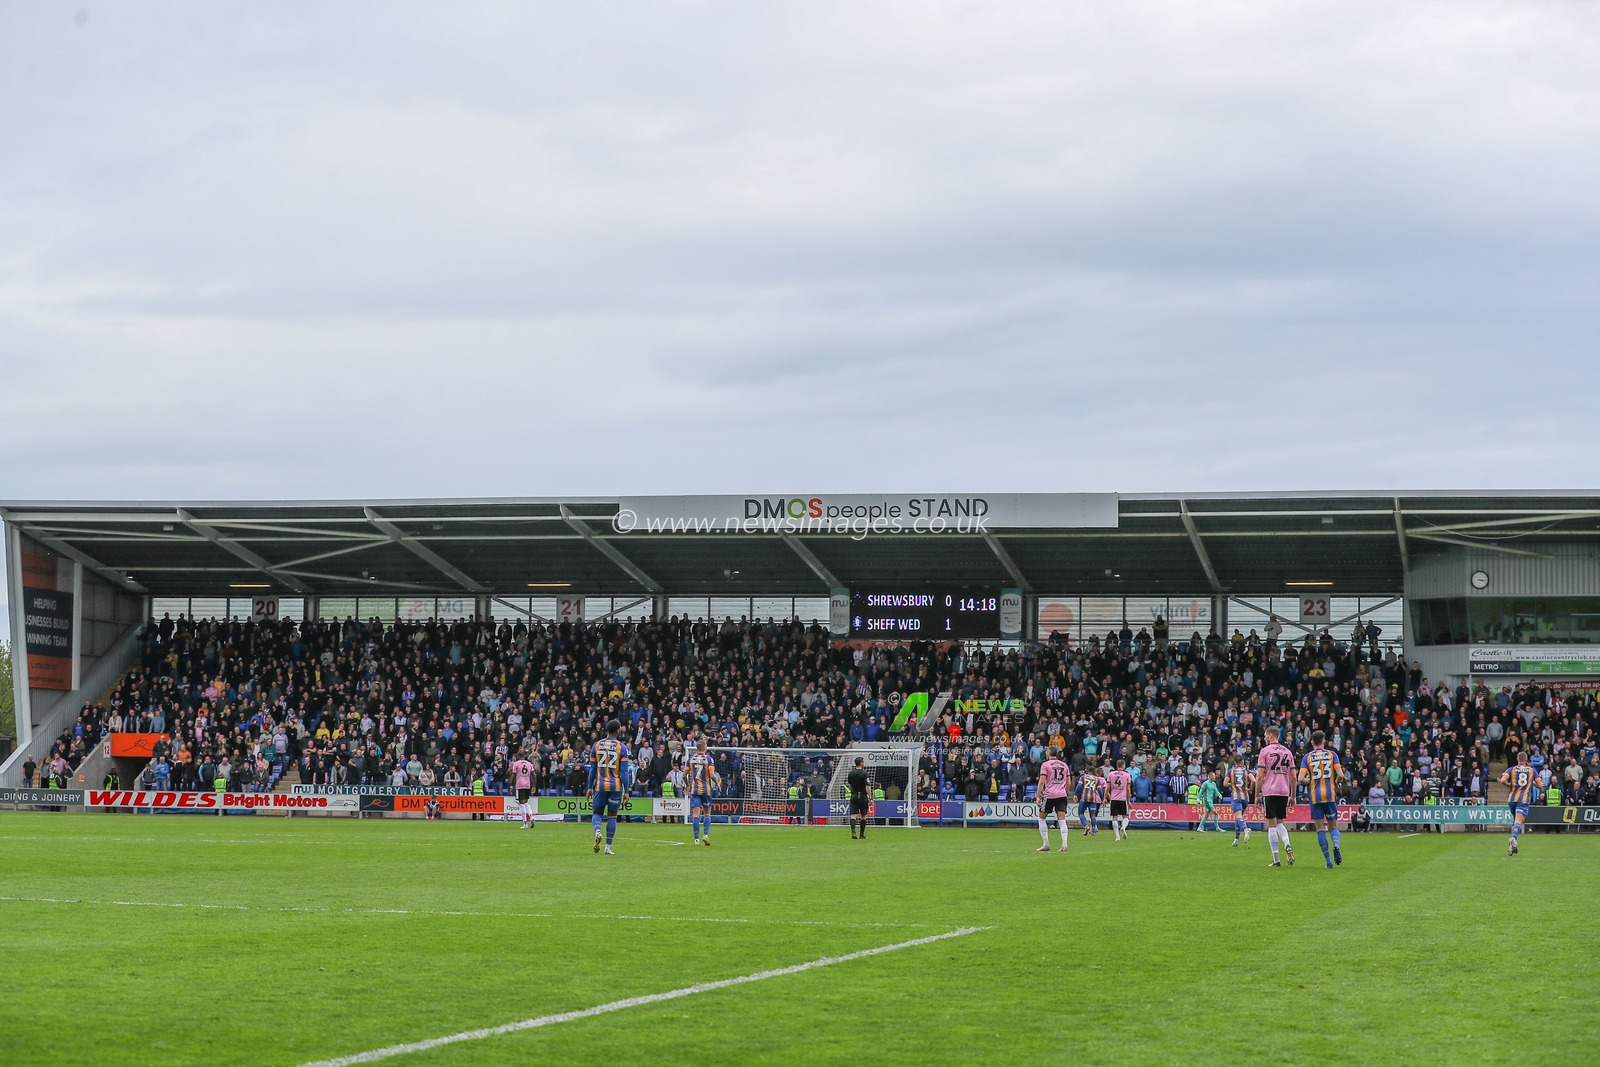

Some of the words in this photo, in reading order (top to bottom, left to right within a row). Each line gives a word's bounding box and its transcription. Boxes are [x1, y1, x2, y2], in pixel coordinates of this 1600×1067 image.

[744, 497, 823, 519] DMOS
[826, 502, 901, 523] people
[908, 498, 989, 517] STAND
[33, 598, 57, 611] HELPING
[255, 600, 276, 616] 20
[561, 599, 581, 615] 21
[867, 594, 935, 607] SHREWSBURY
[945, 594, 952, 607] 0
[959, 598, 997, 611] 14:18
[1303, 598, 1327, 616] 23
[25, 614, 52, 628] USINESSES
[53, 619, 69, 630] BUILD
[867, 618, 896, 630] SHEFF
[897, 618, 921, 630] WED
[945, 618, 951, 630] 1
[27, 632, 51, 646] WINNING
[53, 635, 68, 647] TEAM
[596, 750, 619, 769] 22
[1269, 752, 1290, 771] 24
[521, 764, 528, 775] 6
[694, 764, 704, 779] 7
[1052, 767, 1065, 781] 13
[1309, 760, 1333, 780] 33
[1085, 779, 1096, 790] 24
[1115, 776, 1122, 788] 4
[1235, 774, 1244, 787] 3
[1517, 772, 1528, 786] 8
[31, 793, 39, 801] &
[41, 793, 81, 802] JOINERY
[318, 786, 401, 796] MONTGOMERY
[410, 787, 456, 796] WATERS
[89, 791, 218, 807] WILDES
[223, 793, 270, 808] Bright
[273, 794, 328, 807] Motors
[401, 798, 419, 808] DM
[424, 798, 497, 810] Rcruitment
[829, 802, 850, 815] sky
[921, 804, 941, 814] bet
[1365, 809, 1459, 819] MONTGOMERY
[1468, 810, 1512, 819] WATER
